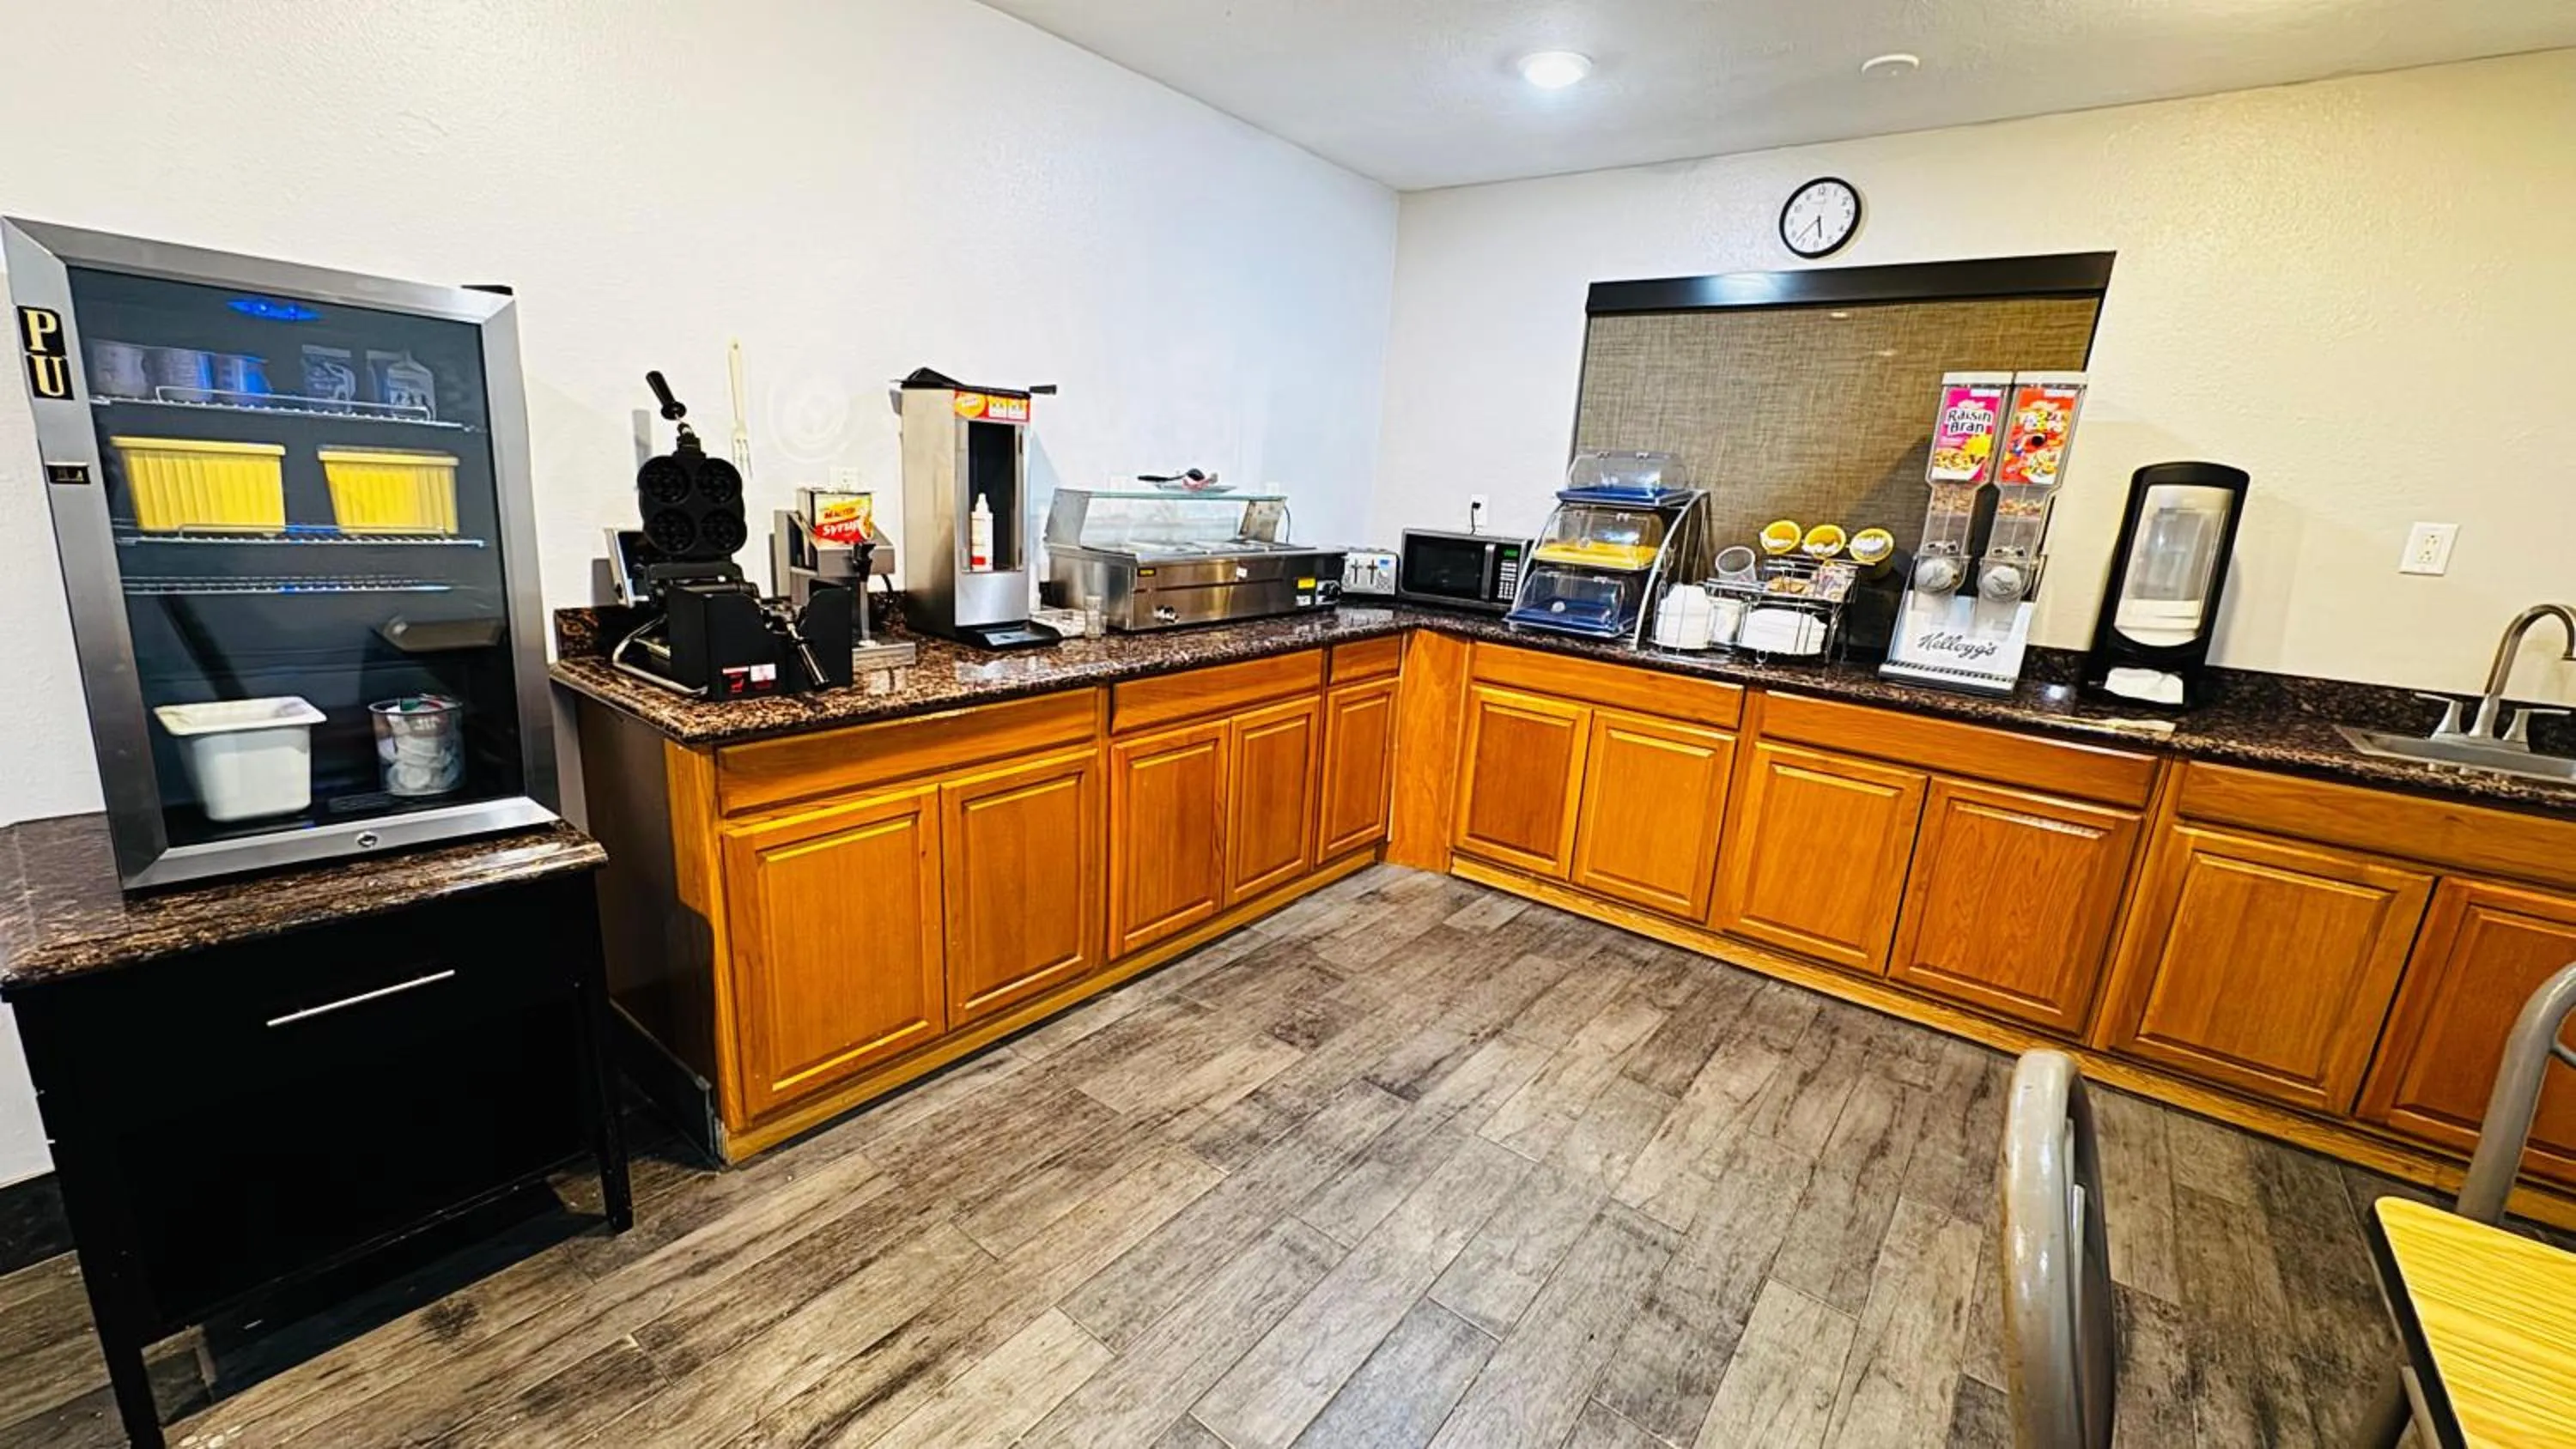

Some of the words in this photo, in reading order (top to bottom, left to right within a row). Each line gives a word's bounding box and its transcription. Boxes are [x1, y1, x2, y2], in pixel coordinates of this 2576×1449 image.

[1947, 409, 1991, 423] Raisin
[1950, 421, 1984, 433] Bran
[1917, 631, 1998, 660] Kellogg's
